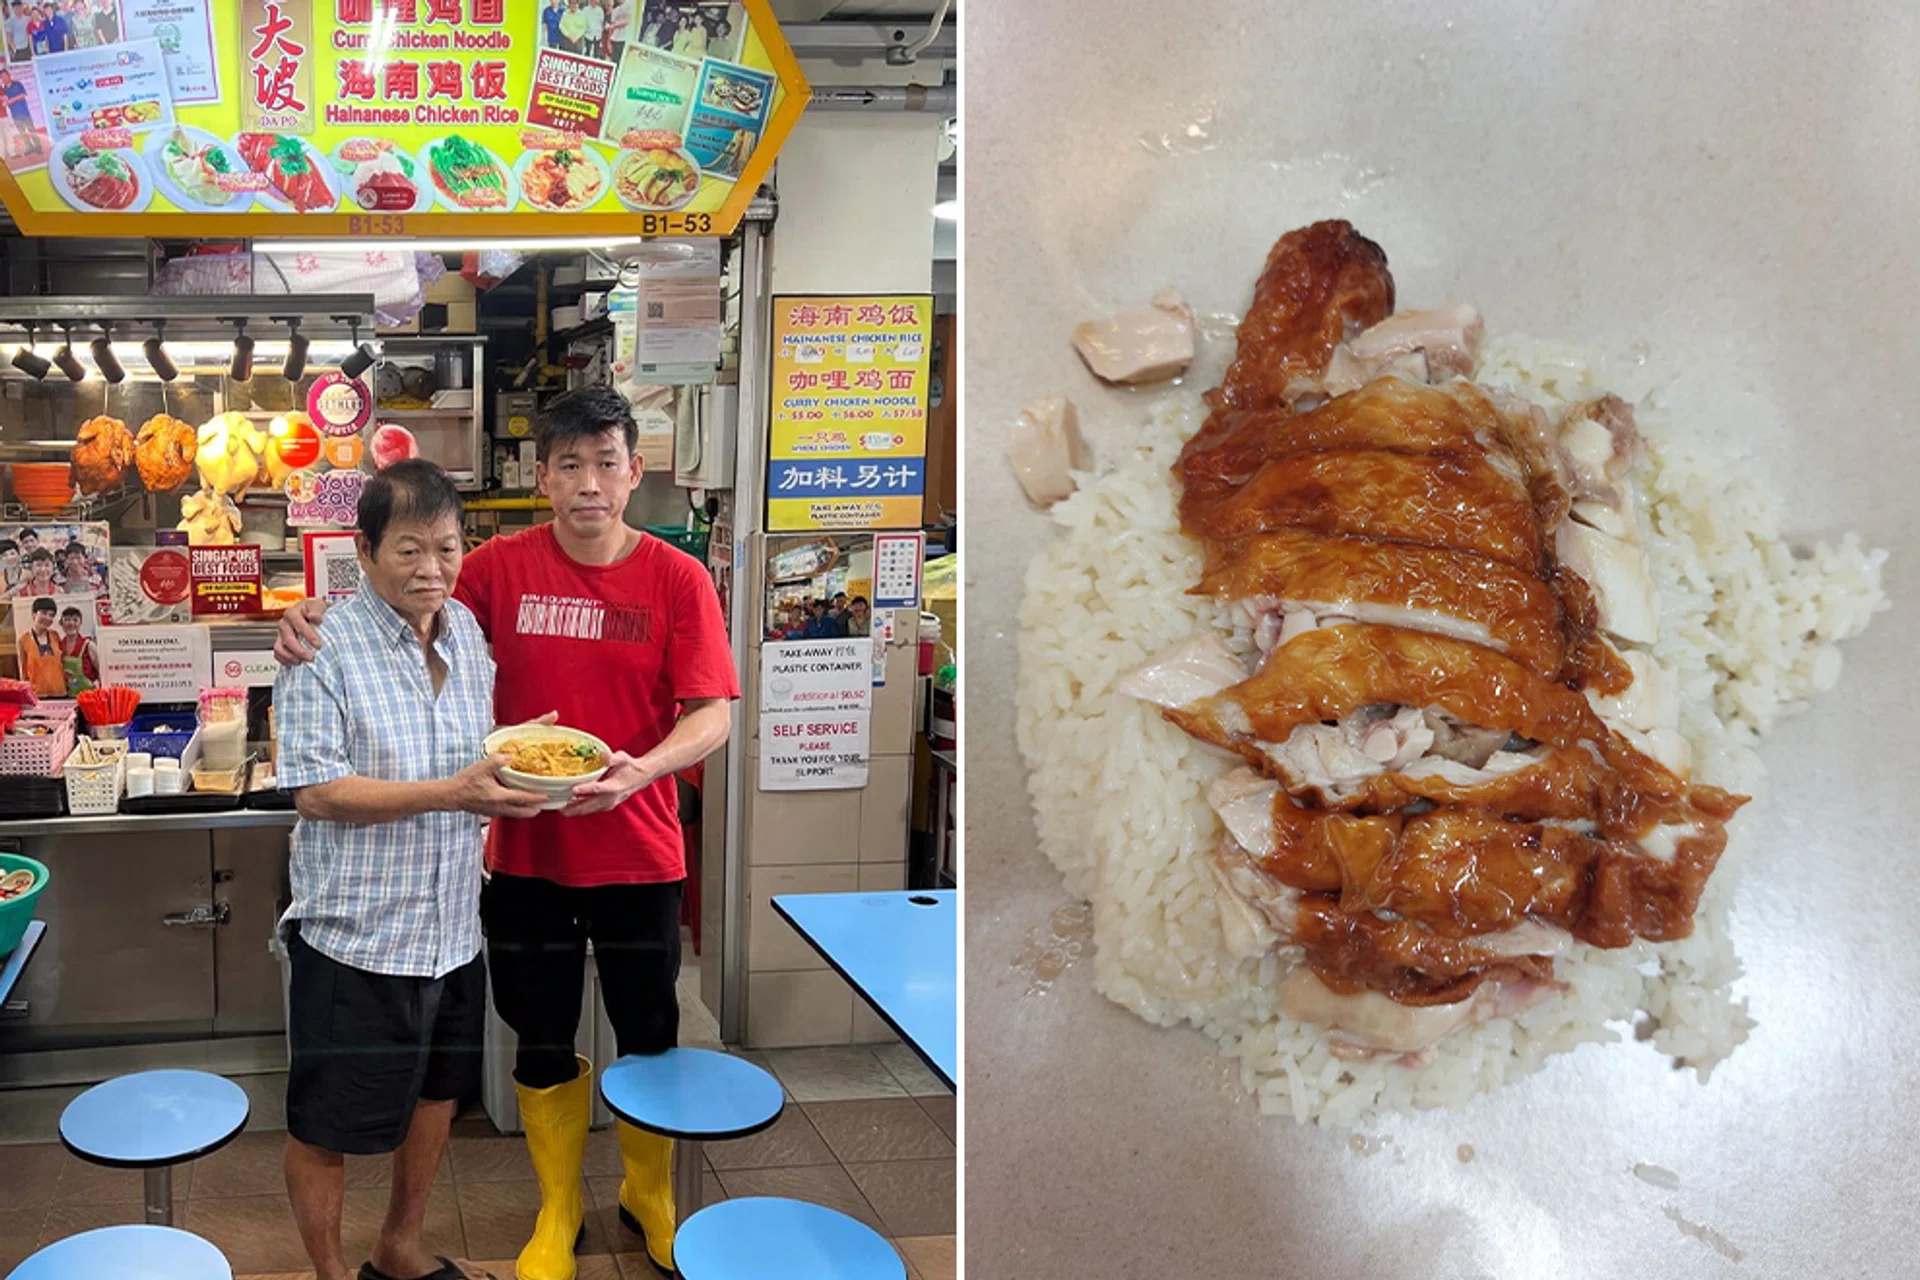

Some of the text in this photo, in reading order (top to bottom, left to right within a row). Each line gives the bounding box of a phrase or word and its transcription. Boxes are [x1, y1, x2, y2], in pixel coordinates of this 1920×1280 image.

[333, 30, 511, 49] Curr hicken Noodle
[251, 4, 306, 112] 大坡
[541, 55, 610, 82] SINGAPORE
[339, 60, 507, 99] 海南鸡饭
[538, 68, 566, 88] BEST
[569, 76, 606, 95] FOODS
[326, 105, 519, 123] Hainanese Chicken Rice
[349, 216, 405, 235] B1-53
[643, 215, 712, 234] B1-53
[790, 303, 918, 326] 海南鸡饭
[783, 333, 923, 345] HAINANESE CHICKEN RICE
[789, 368, 917, 391] 咖哩鸡面
[783, 396, 917, 407] CURRY CHICKEN NOODLE
[792, 410, 824, 420] $5.00
[778, 464, 917, 490] 加料另计
[192, 549, 258, 563] SINGAPORE
[194, 562, 219, 575] BEST
[223, 562, 256, 574] FOODS
[244, 664, 277, 673] CLEAN
[772, 662, 862, 674] PLASTIC CONTAINER
[793, 692, 839, 701] additional
[773, 722, 858, 737] SELF SERVICE
[771, 756, 798, 765] THANK
[800, 755, 817, 763] YOU
[819, 755, 836, 763] FOR
